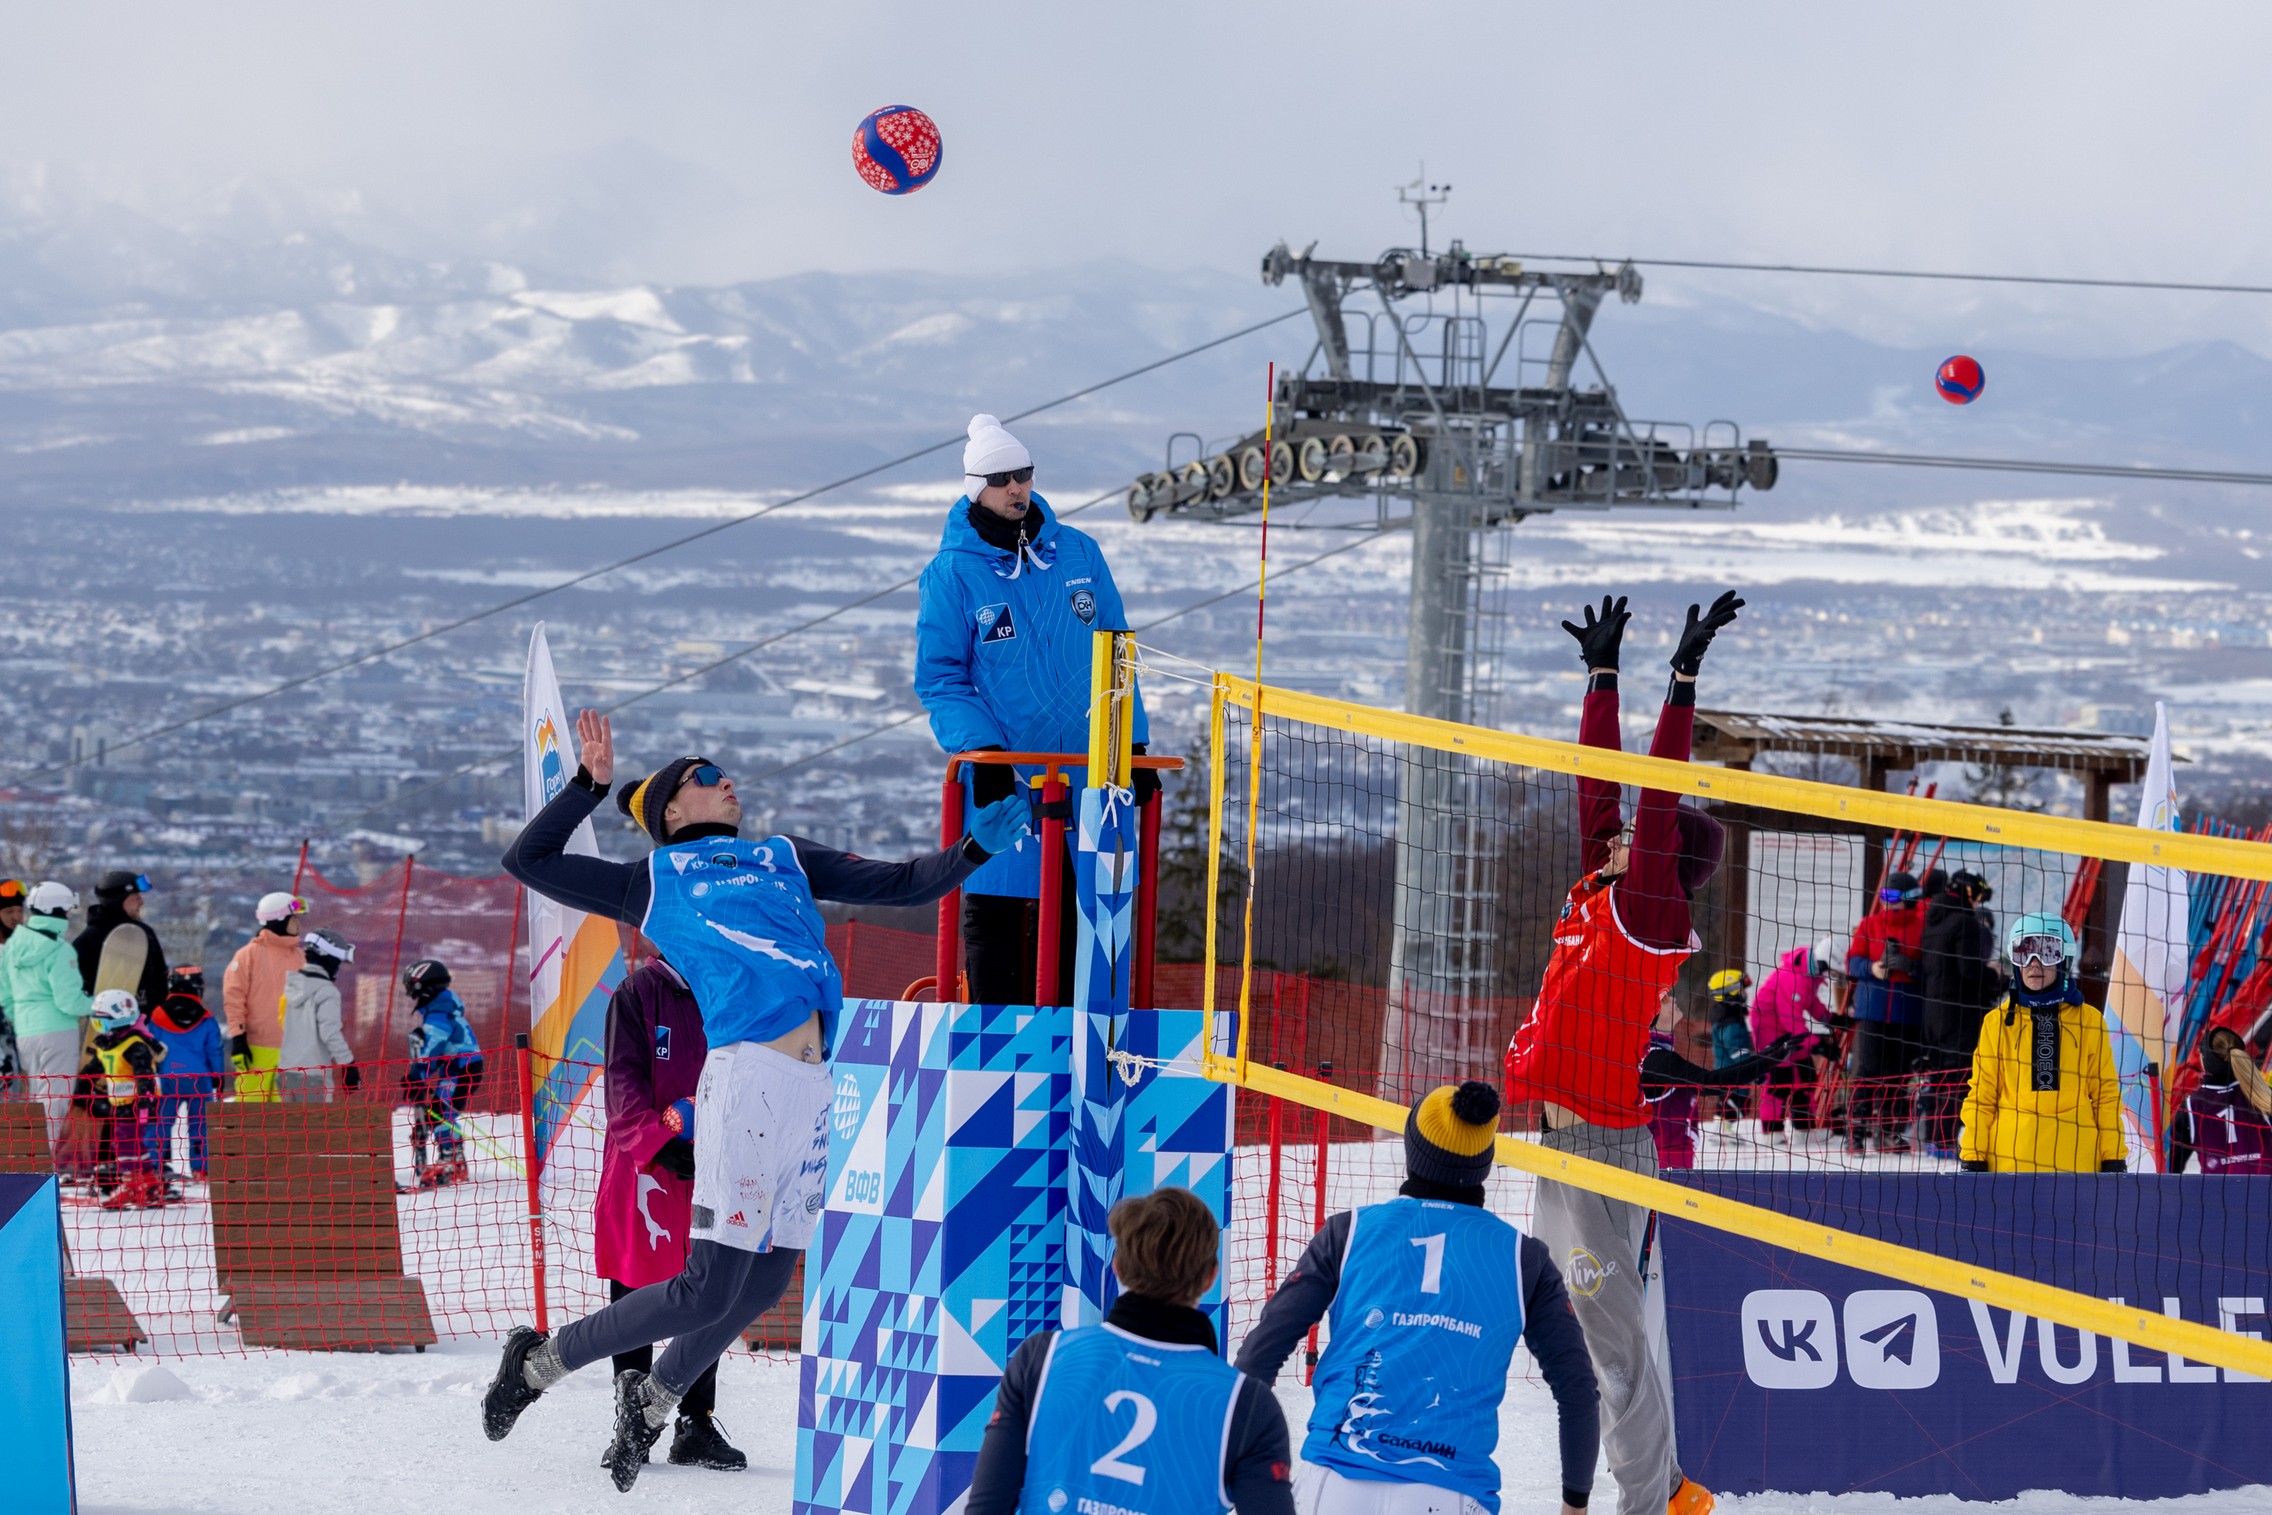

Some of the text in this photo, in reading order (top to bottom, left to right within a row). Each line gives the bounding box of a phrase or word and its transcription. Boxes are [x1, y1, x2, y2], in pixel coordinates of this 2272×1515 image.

[752, 846, 777, 873] 3
[2216, 1105, 2238, 1144] 1
[844, 1169, 881, 1205] ВФВ
[1410, 1232, 1447, 1295] 1
[1392, 1311, 1482, 1339] ГАЗПРОМБАНК
[1756, 1319, 1823, 1362] VK
[1090, 1389, 1158, 1486] 2
